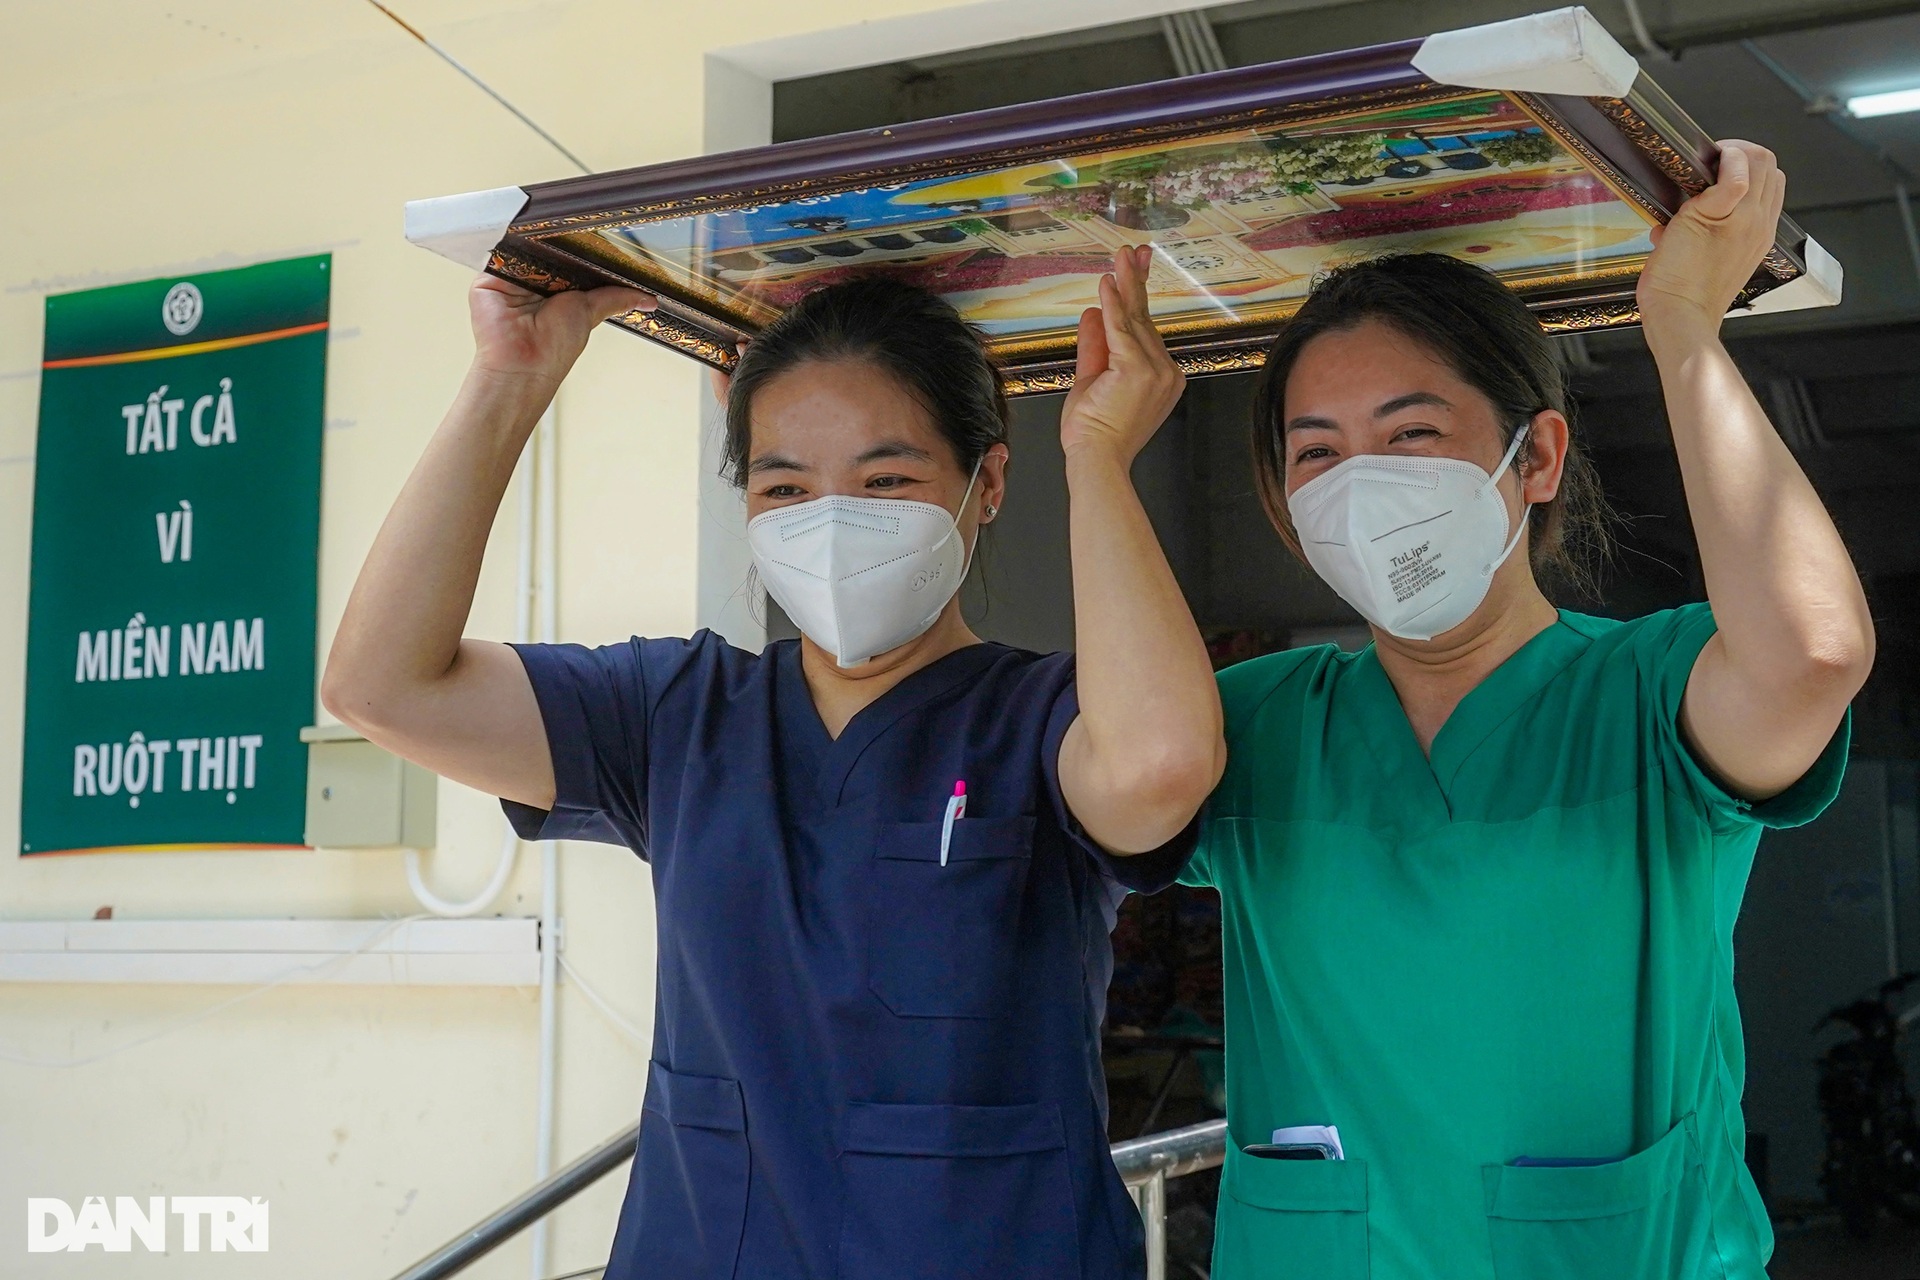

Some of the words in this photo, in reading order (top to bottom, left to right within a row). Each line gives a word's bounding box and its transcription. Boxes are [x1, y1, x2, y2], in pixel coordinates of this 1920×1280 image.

[122, 385, 184, 455] TẤT
[190, 377, 237, 447] CẢ
[156, 500, 193, 563] VÌ
[1397, 591, 1415, 603] MADE
[1422, 569, 1446, 588] VIETNAM
[75, 612, 171, 683] MIỀN
[179, 617, 265, 676] NAM
[73, 733, 171, 809] RUỘT
[177, 735, 263, 804] THỊT
